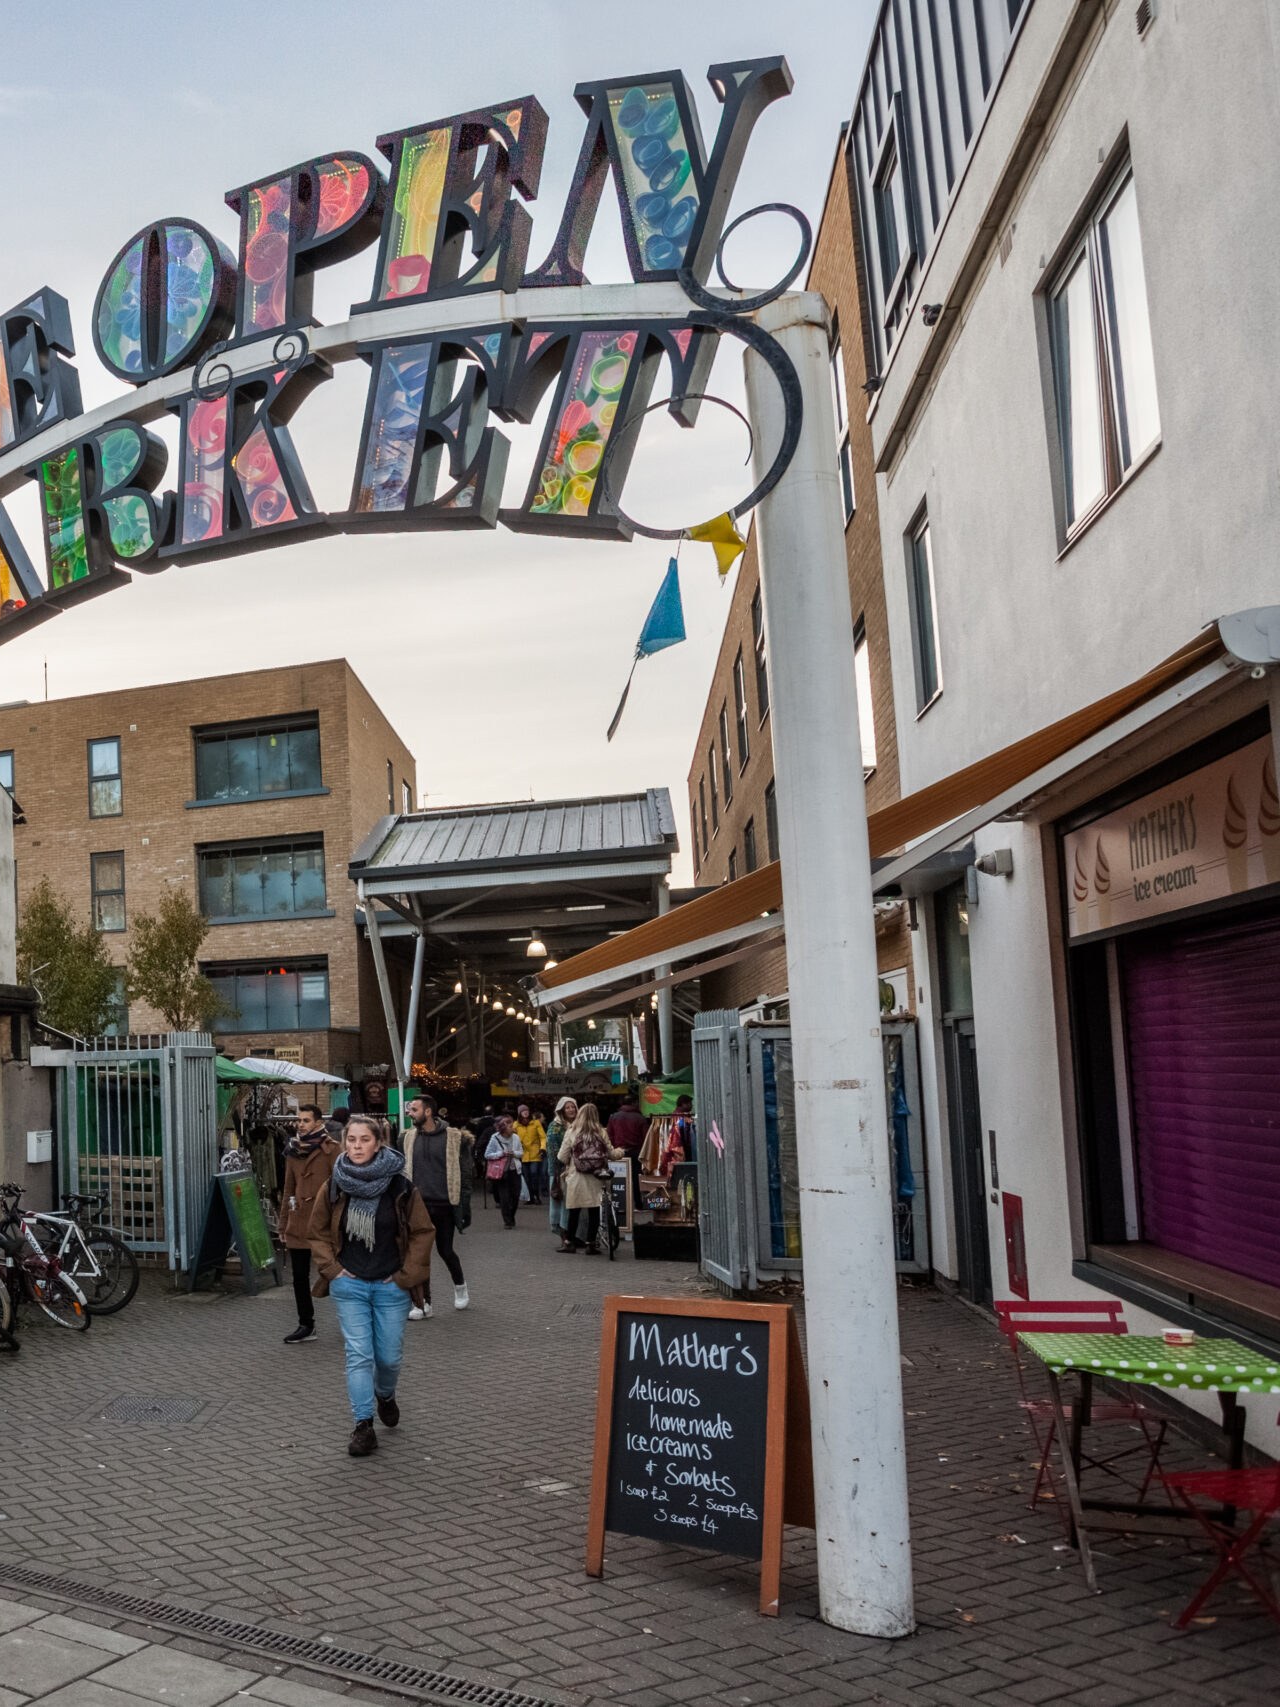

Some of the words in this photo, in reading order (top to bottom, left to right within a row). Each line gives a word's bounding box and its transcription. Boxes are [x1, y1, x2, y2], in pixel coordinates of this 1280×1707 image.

[92, 53, 794, 384] OPEN
[1128, 793, 1197, 871] MATHER'S
[1133, 876, 1151, 902] ice
[1153, 864, 1197, 897] cream
[628, 1322, 757, 1375] Mather's
[628, 1375, 700, 1407] delicious
[651, 1486, 670, 1501] £2
[688, 1494, 699, 1507] 2
[739, 1503, 758, 1520] £3
[654, 1508, 667, 1521] 3
[701, 1514, 719, 1534] £4
